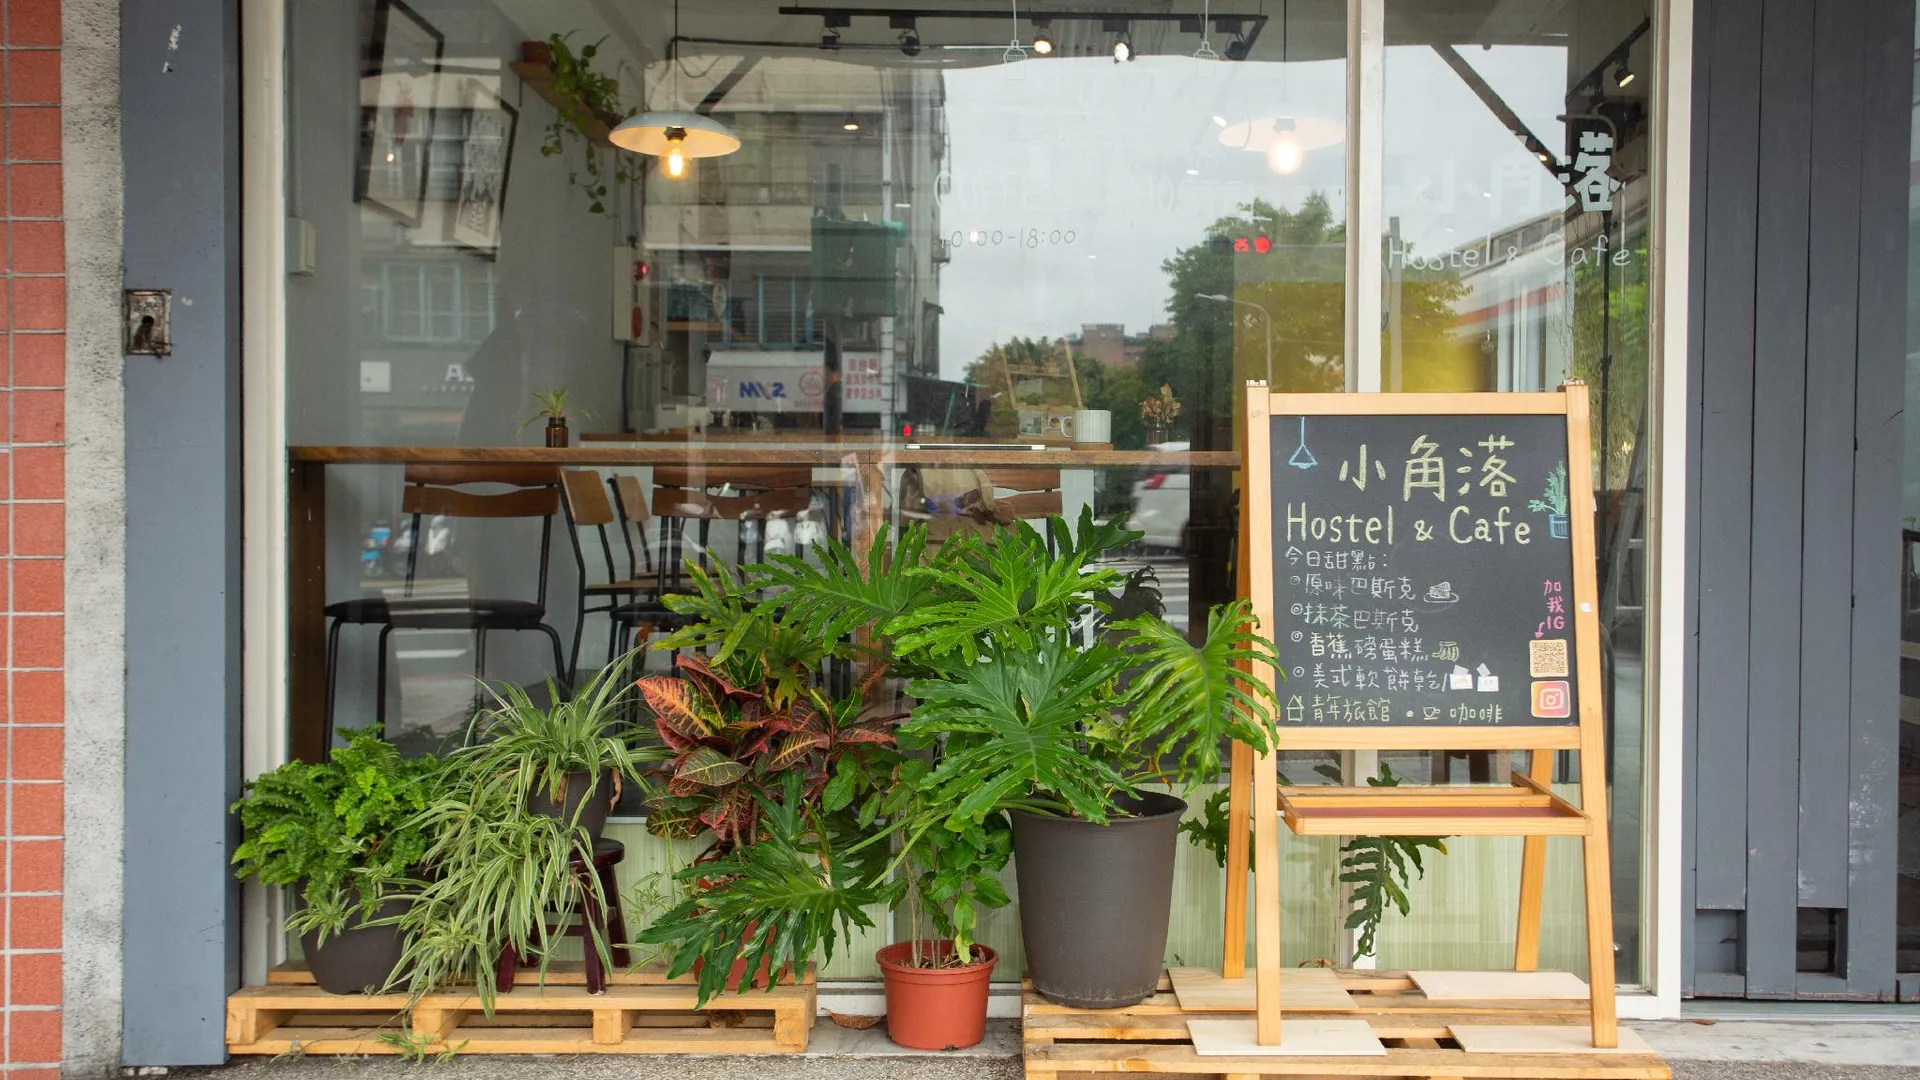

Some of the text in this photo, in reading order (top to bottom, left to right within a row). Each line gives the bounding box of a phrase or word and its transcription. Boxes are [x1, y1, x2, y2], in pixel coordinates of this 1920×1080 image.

[1388, 232, 1491, 270] Hostel
[1339, 434, 1517, 502] 小角落
[1287, 502, 1531, 545] Hostel & Cafe
[1305, 572, 1417, 600] 原味巴斯克
[1303, 602, 1420, 633] 抹茶巴斯克
[1309, 631, 1429, 663] 香蕉磅蛋糕
[1311, 694, 1504, 725] 青年旅館 咖啡
